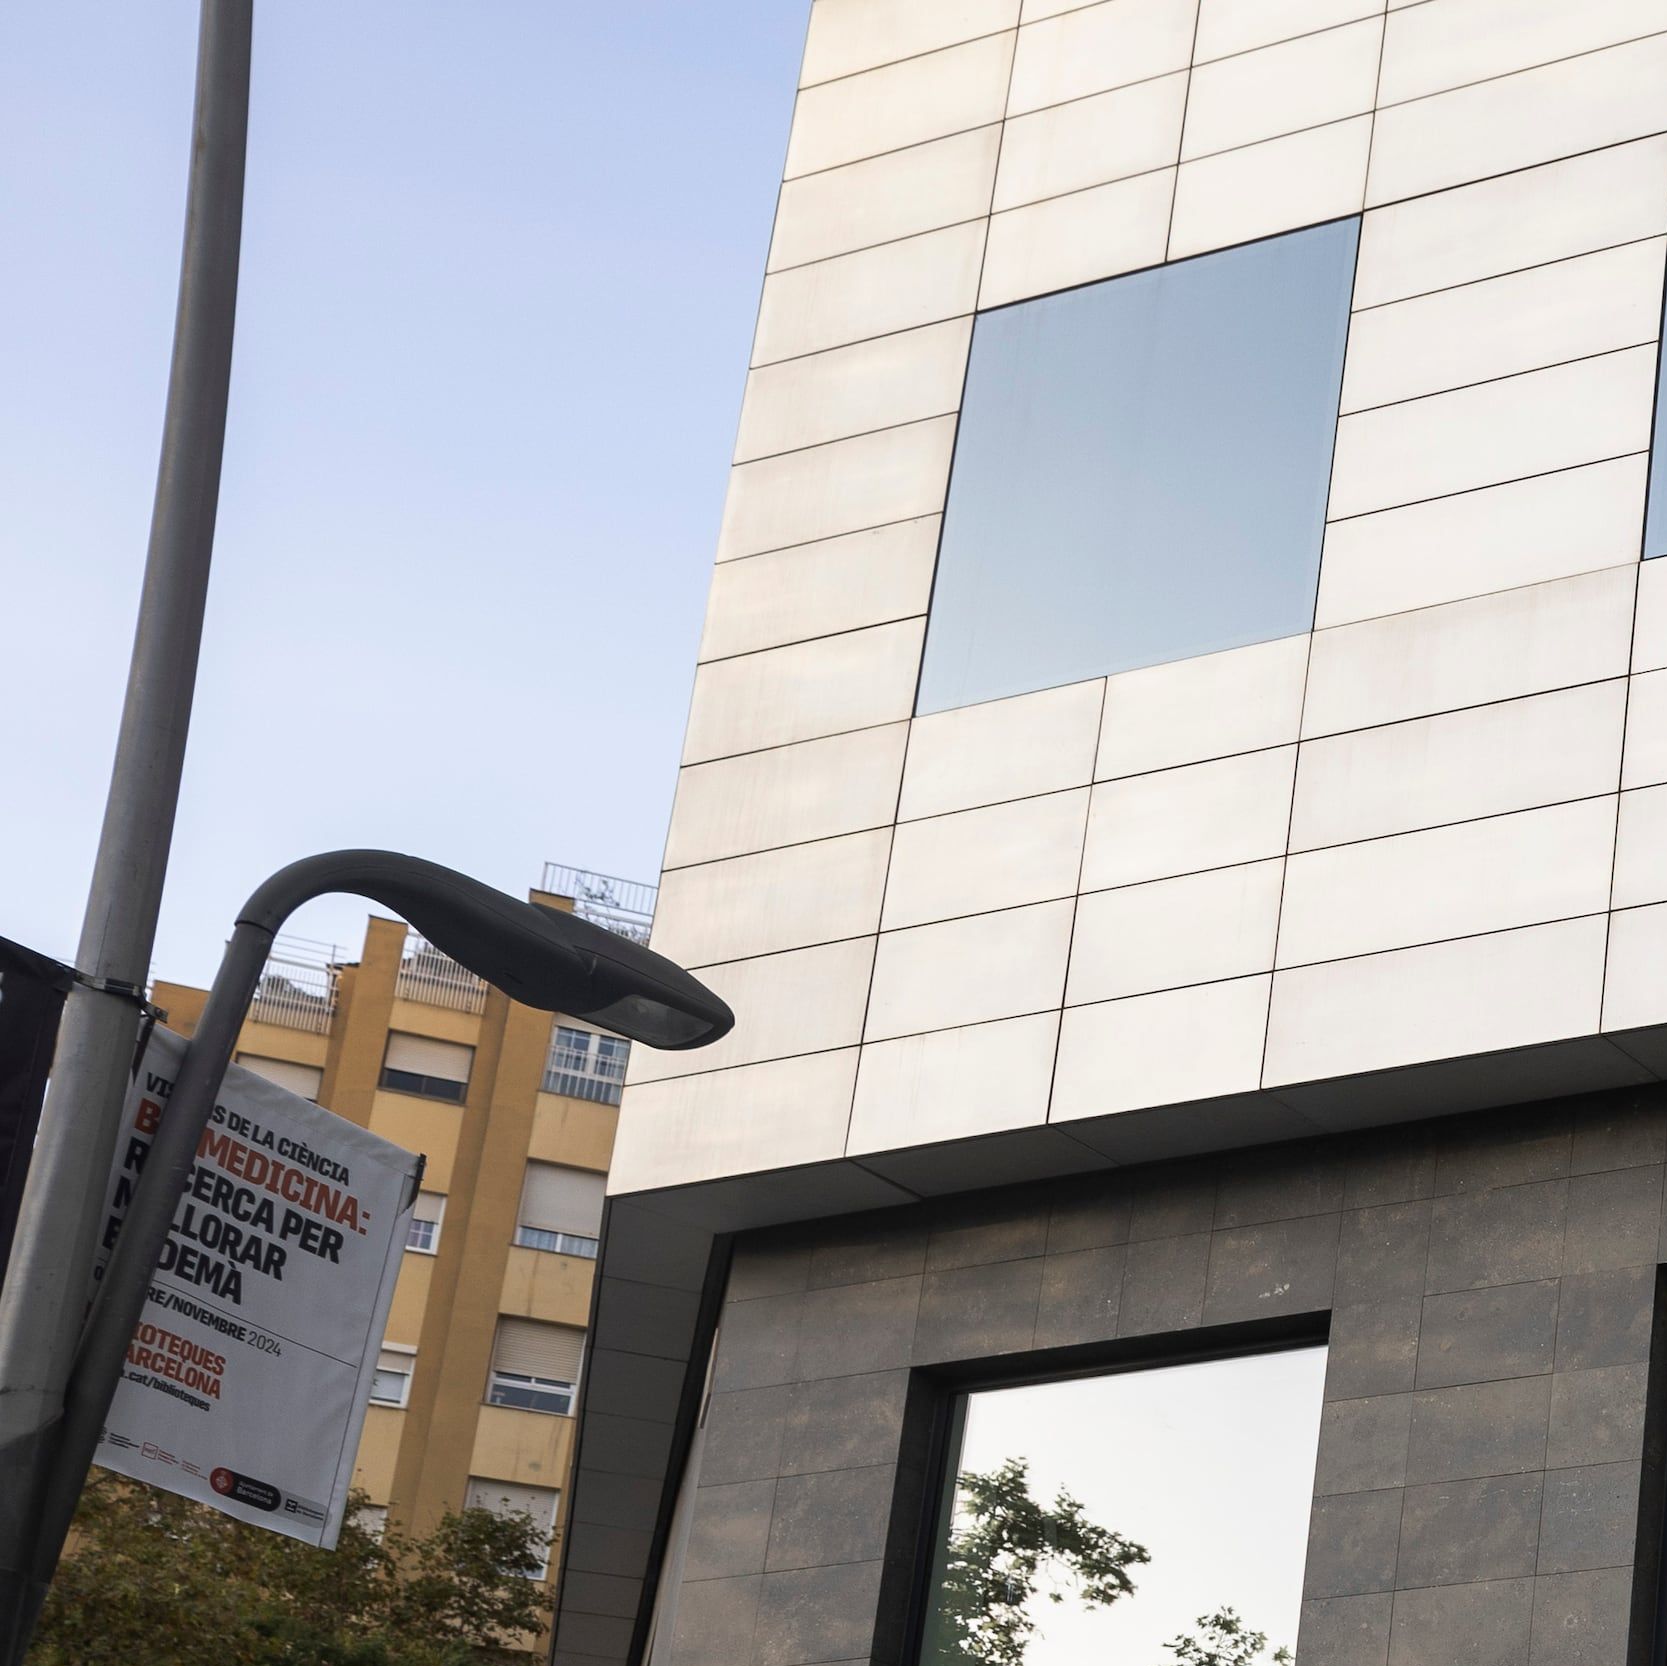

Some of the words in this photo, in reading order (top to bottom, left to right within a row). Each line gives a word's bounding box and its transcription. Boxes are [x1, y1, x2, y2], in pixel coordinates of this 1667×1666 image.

[134, 1098, 371, 1236] BMEDICINA:
[228, 1112, 251, 1137] DE
[252, 1124, 274, 1149] LA
[277, 1136, 351, 1187] CIÈNCIA
[279, 1208, 344, 1264] PER
[248, 1330, 282, 1357] 2024
